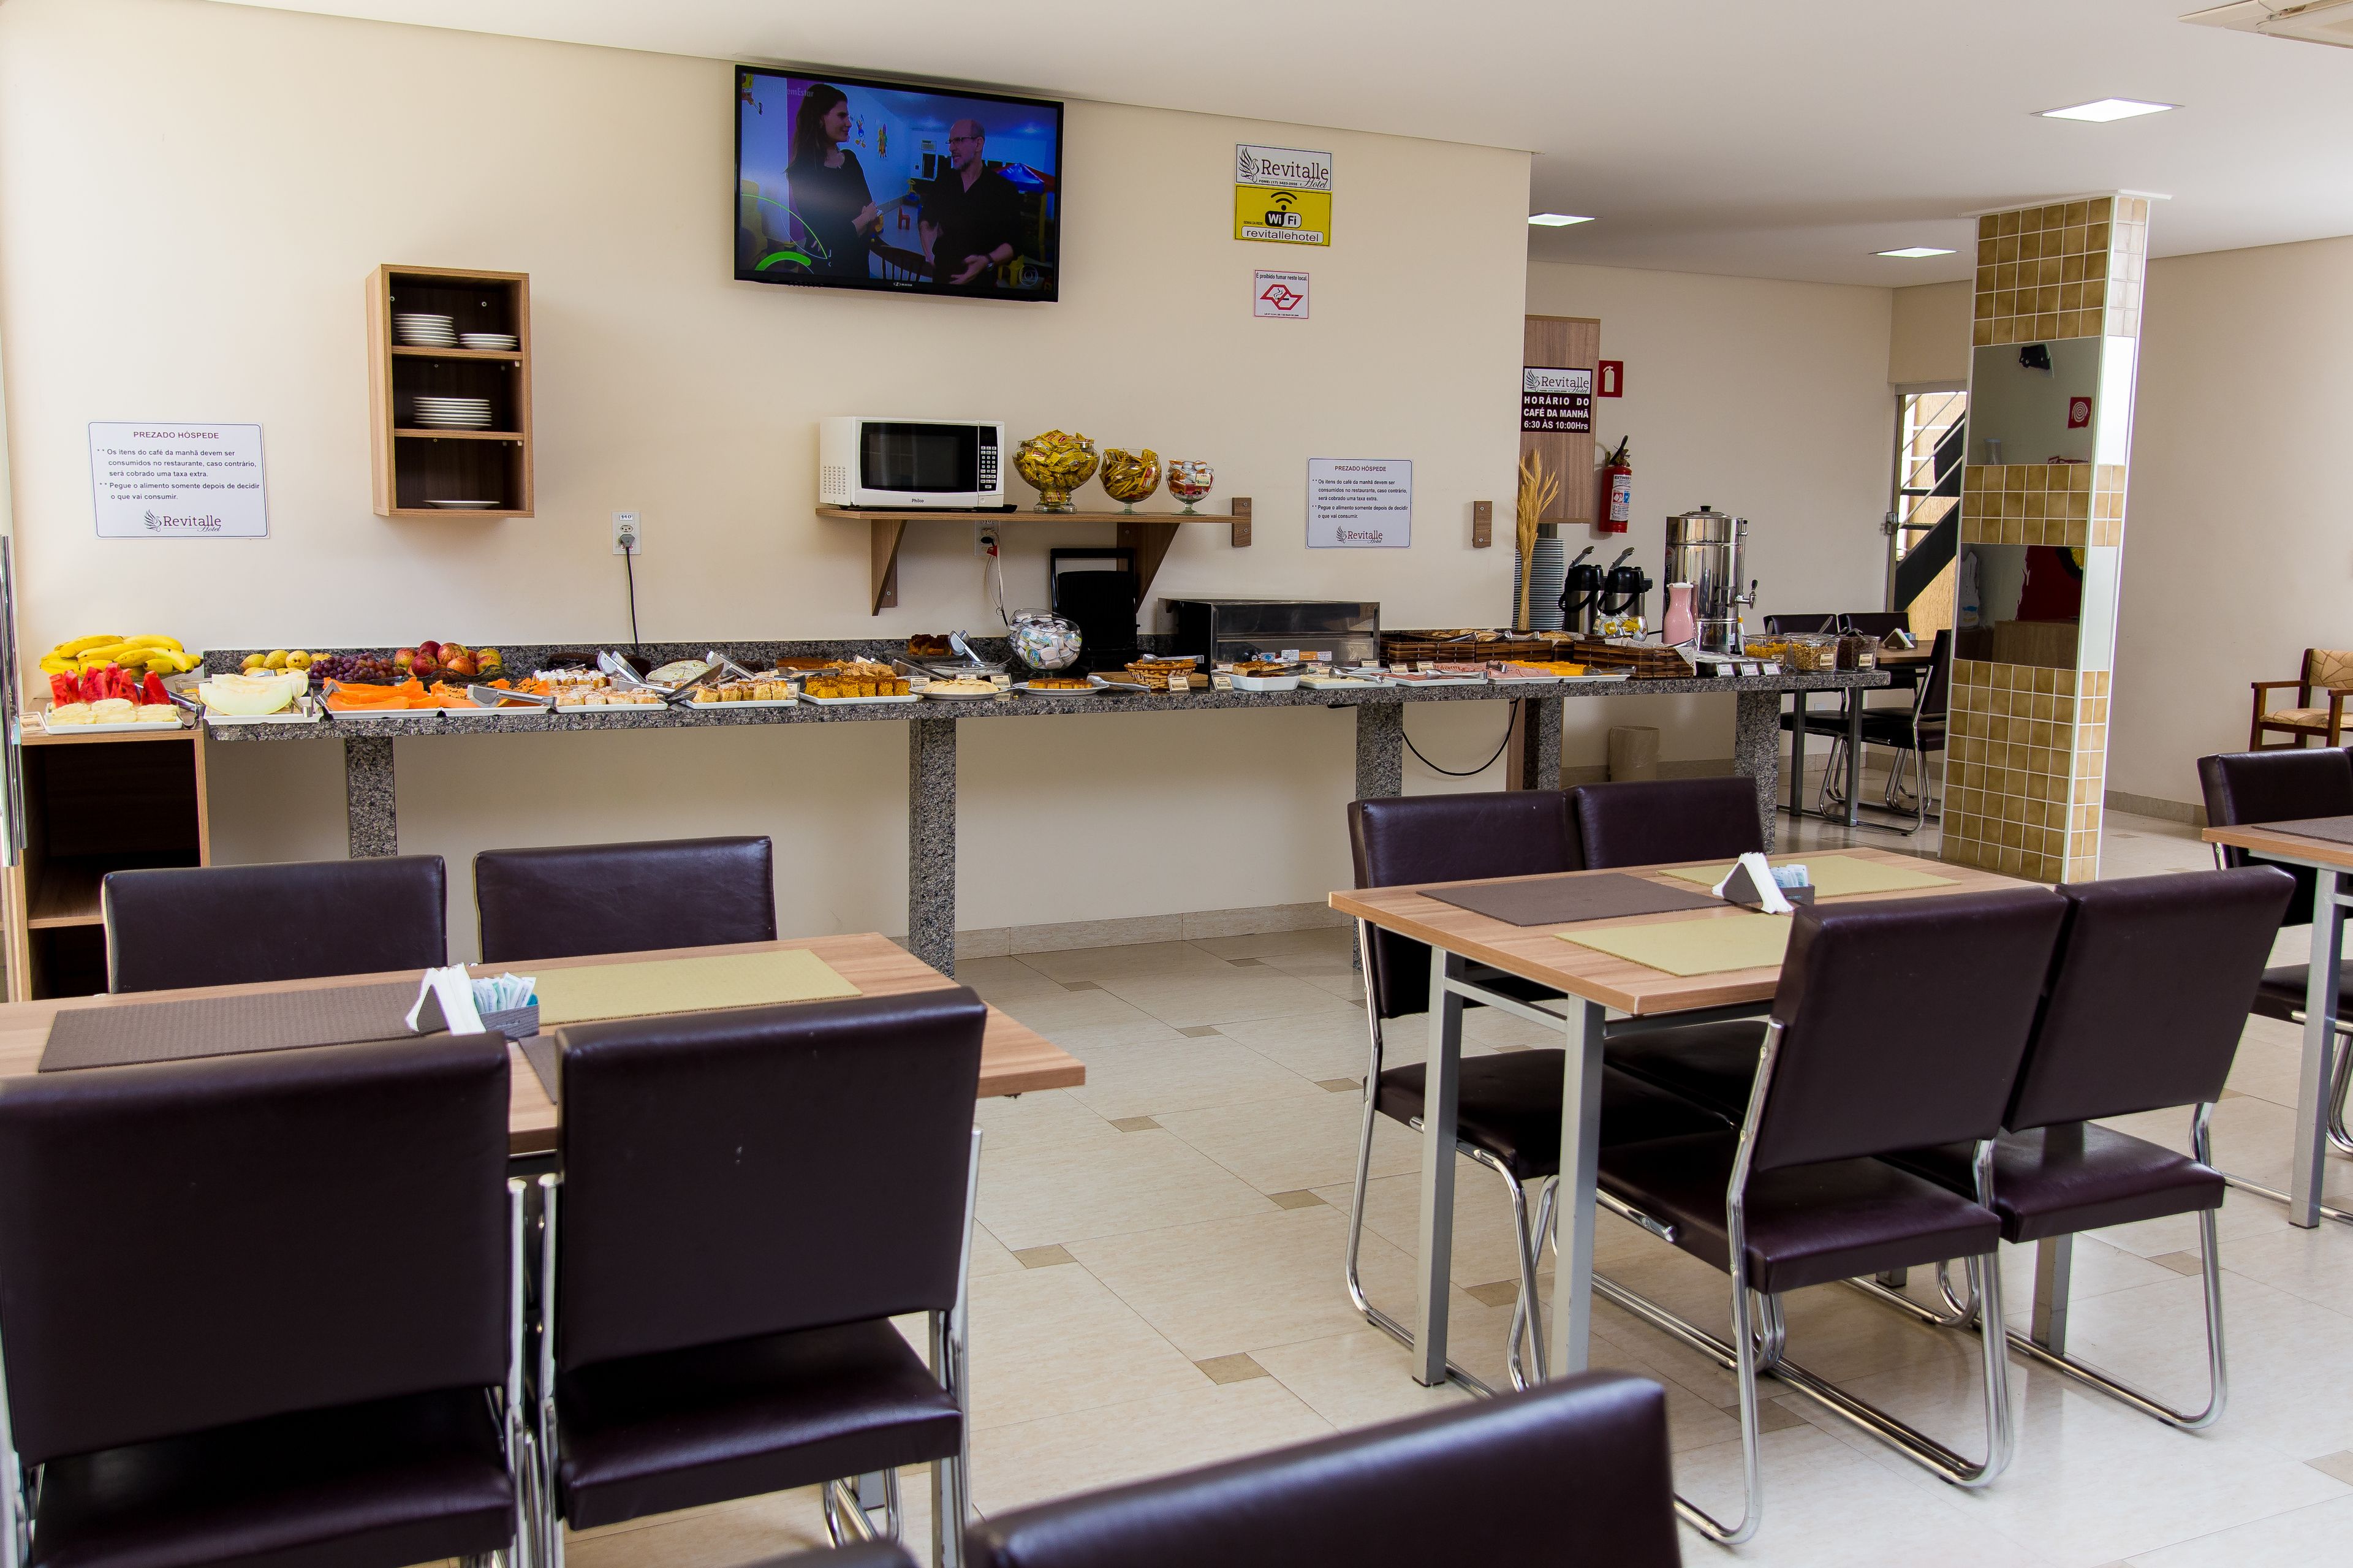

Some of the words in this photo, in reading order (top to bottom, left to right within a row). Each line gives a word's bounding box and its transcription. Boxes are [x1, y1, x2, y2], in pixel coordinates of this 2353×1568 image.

[1261, 159, 1328, 180] Revitalle
[1302, 178, 1328, 189] Hotel
[1246, 230, 1319, 242] revitallehotel
[1541, 376, 1589, 388] Revitalle
[1524, 395, 1569, 405] HORÁRIO
[1524, 407, 1545, 417] CAFÉ
[1547, 409, 1558, 417] DA
[1560, 409, 1588, 419] MANHÃ
[1542, 419, 1553, 429] ÀS
[163, 515, 221, 527] Revitalle
[197, 524, 221, 532] Hotel
[1347, 530, 1382, 540] Revitalle
